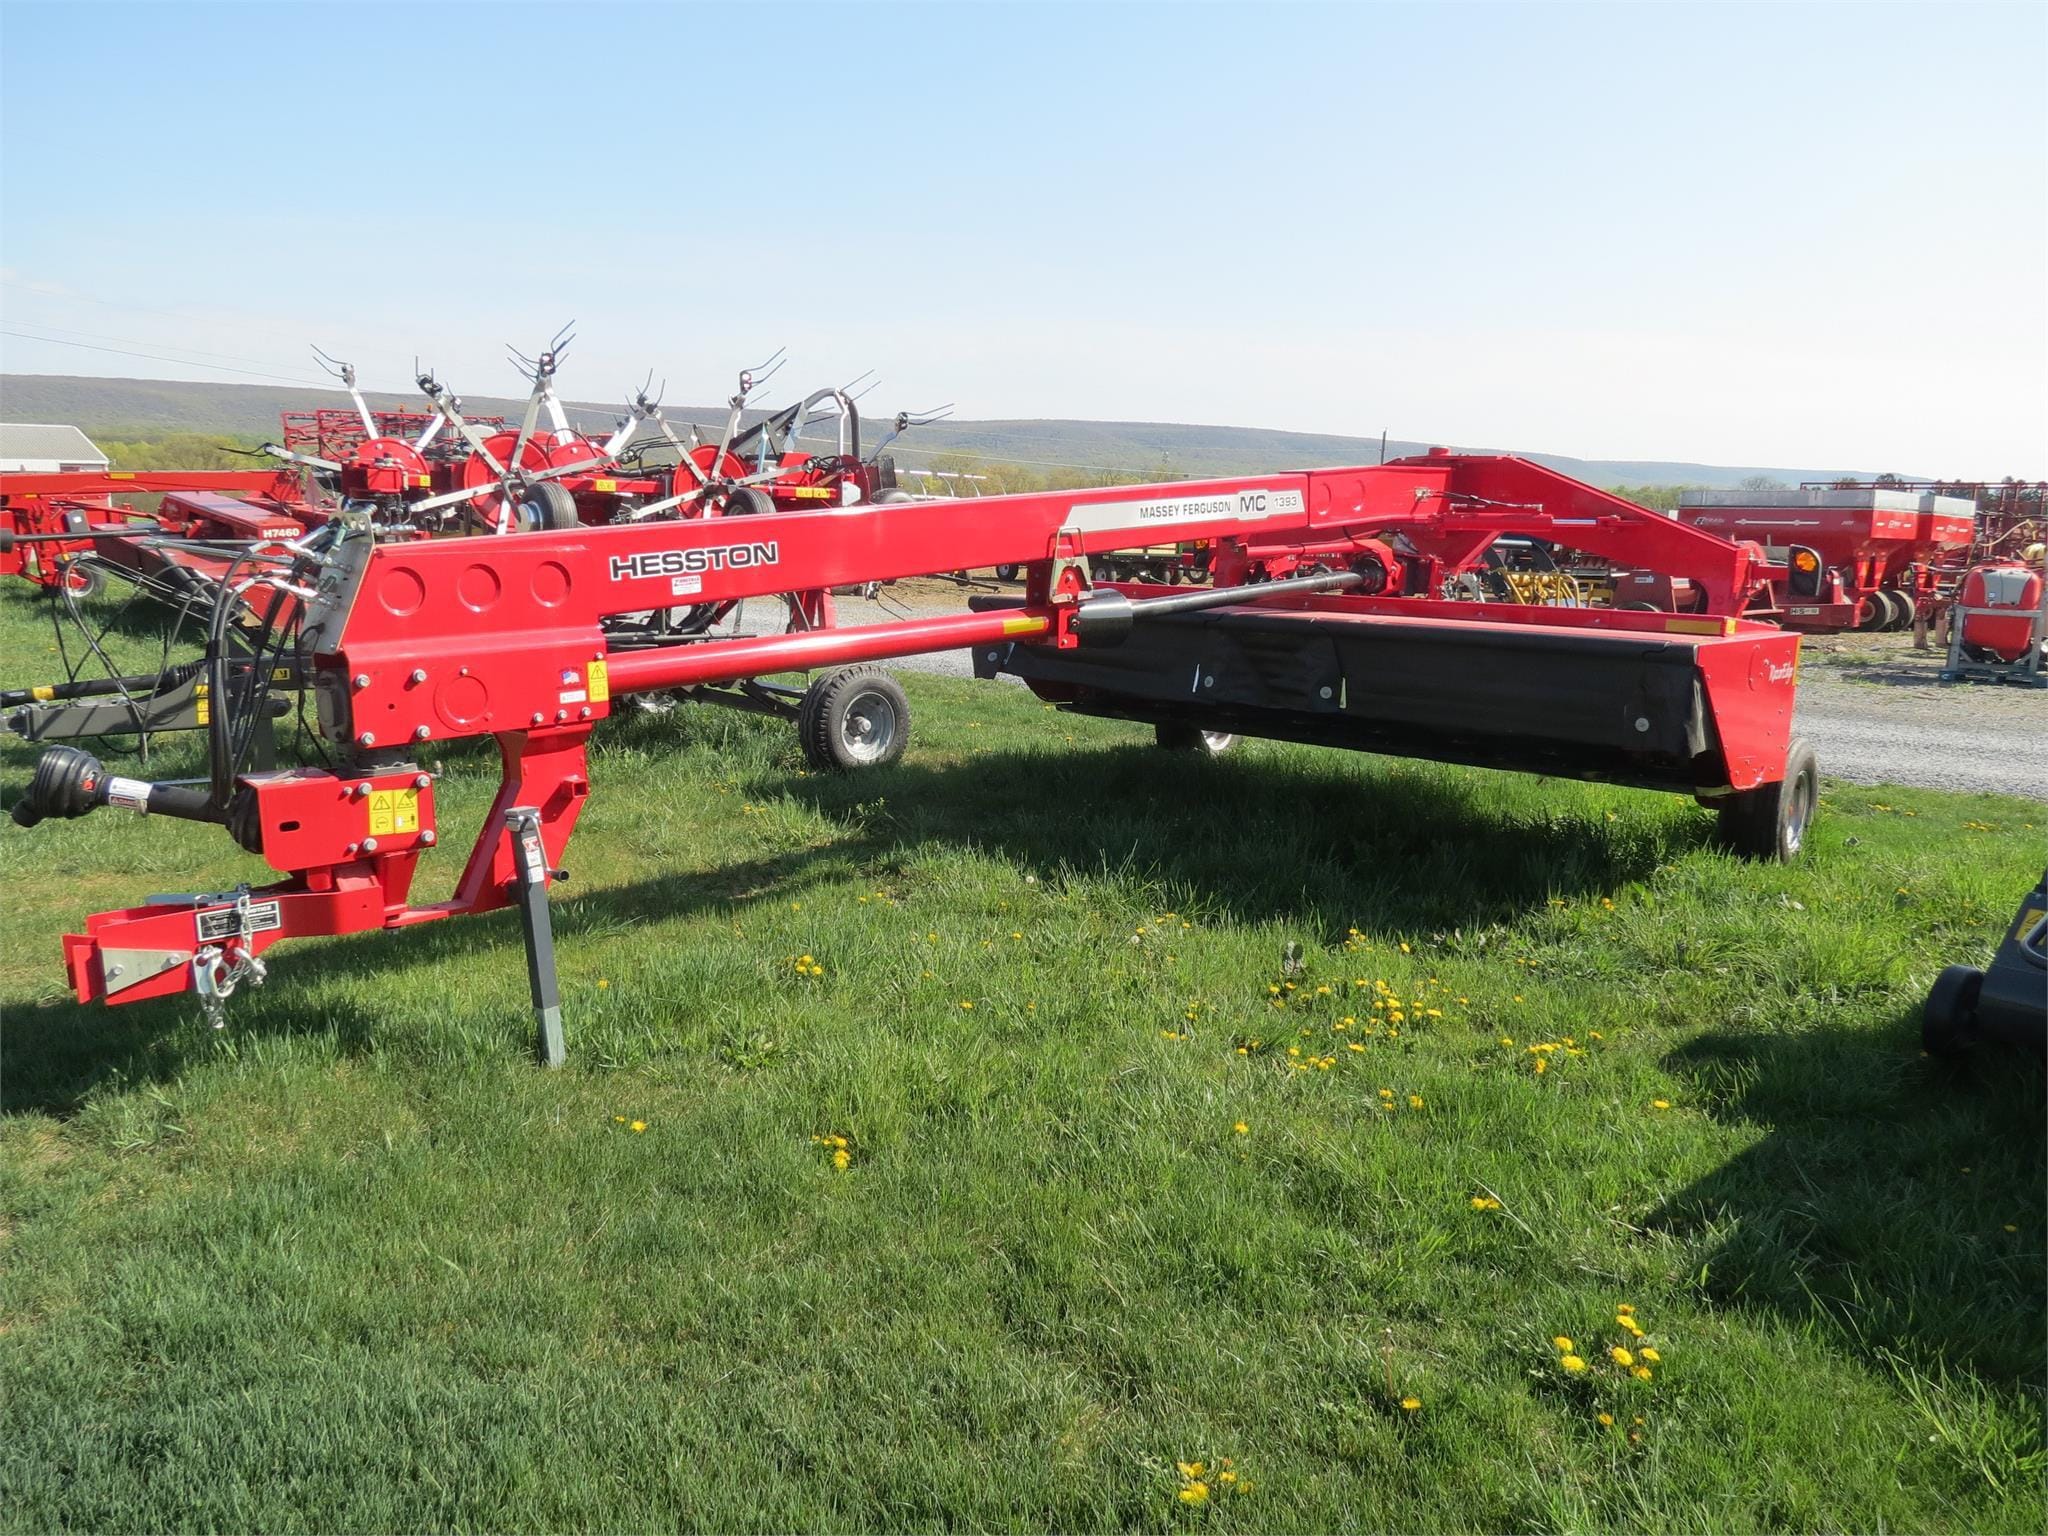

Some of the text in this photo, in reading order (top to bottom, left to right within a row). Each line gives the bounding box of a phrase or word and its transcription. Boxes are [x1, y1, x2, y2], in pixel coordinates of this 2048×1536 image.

[1139, 494, 1298, 519] MASSEY FERGUSON MC 1393
[263, 527, 301, 539] H7460
[610, 542, 778, 581] HESSTON
